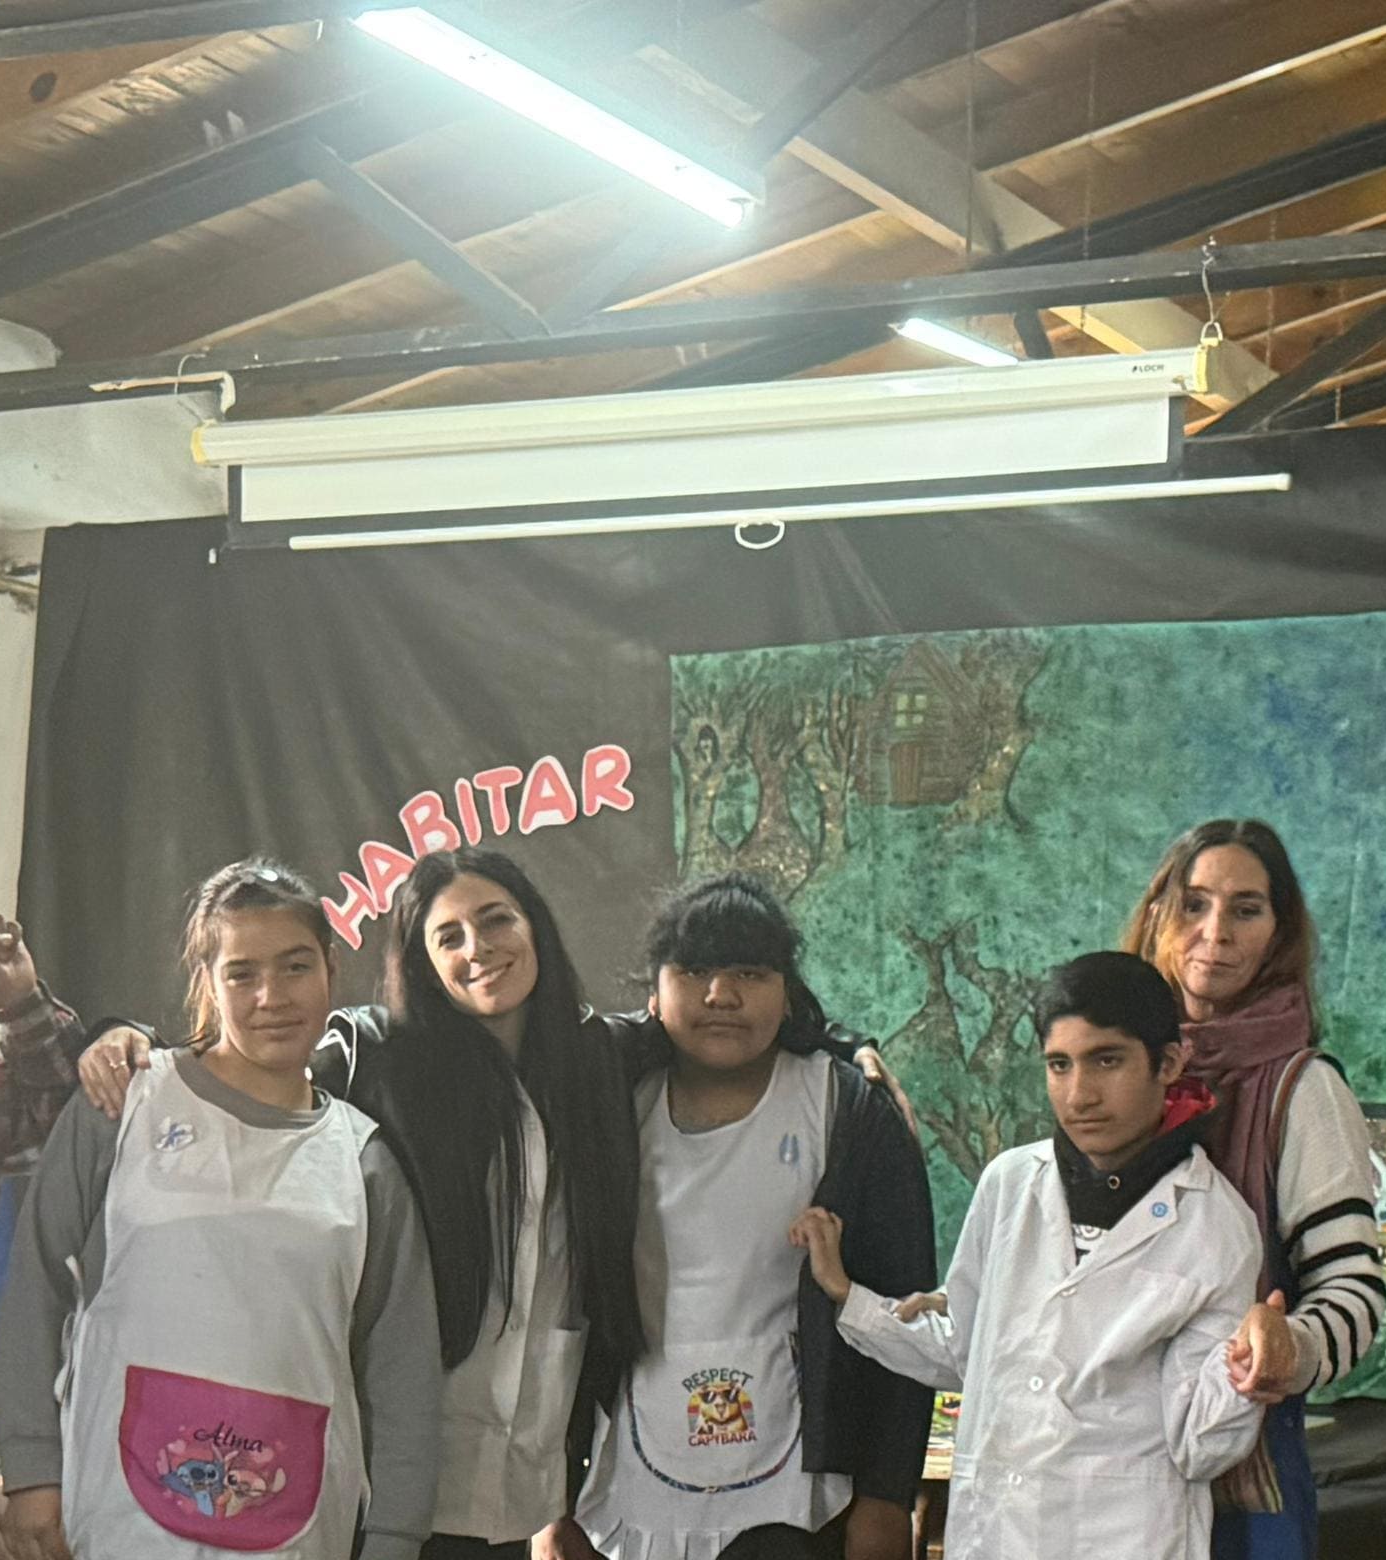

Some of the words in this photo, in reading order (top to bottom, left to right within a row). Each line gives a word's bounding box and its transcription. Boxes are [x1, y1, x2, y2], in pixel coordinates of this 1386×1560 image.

[320, 744, 634, 950] HABITAR
[681, 1367, 754, 1393] RESPECT
[193, 1421, 263, 1453] Alma
[688, 1430, 757, 1447] CAPYBARA
